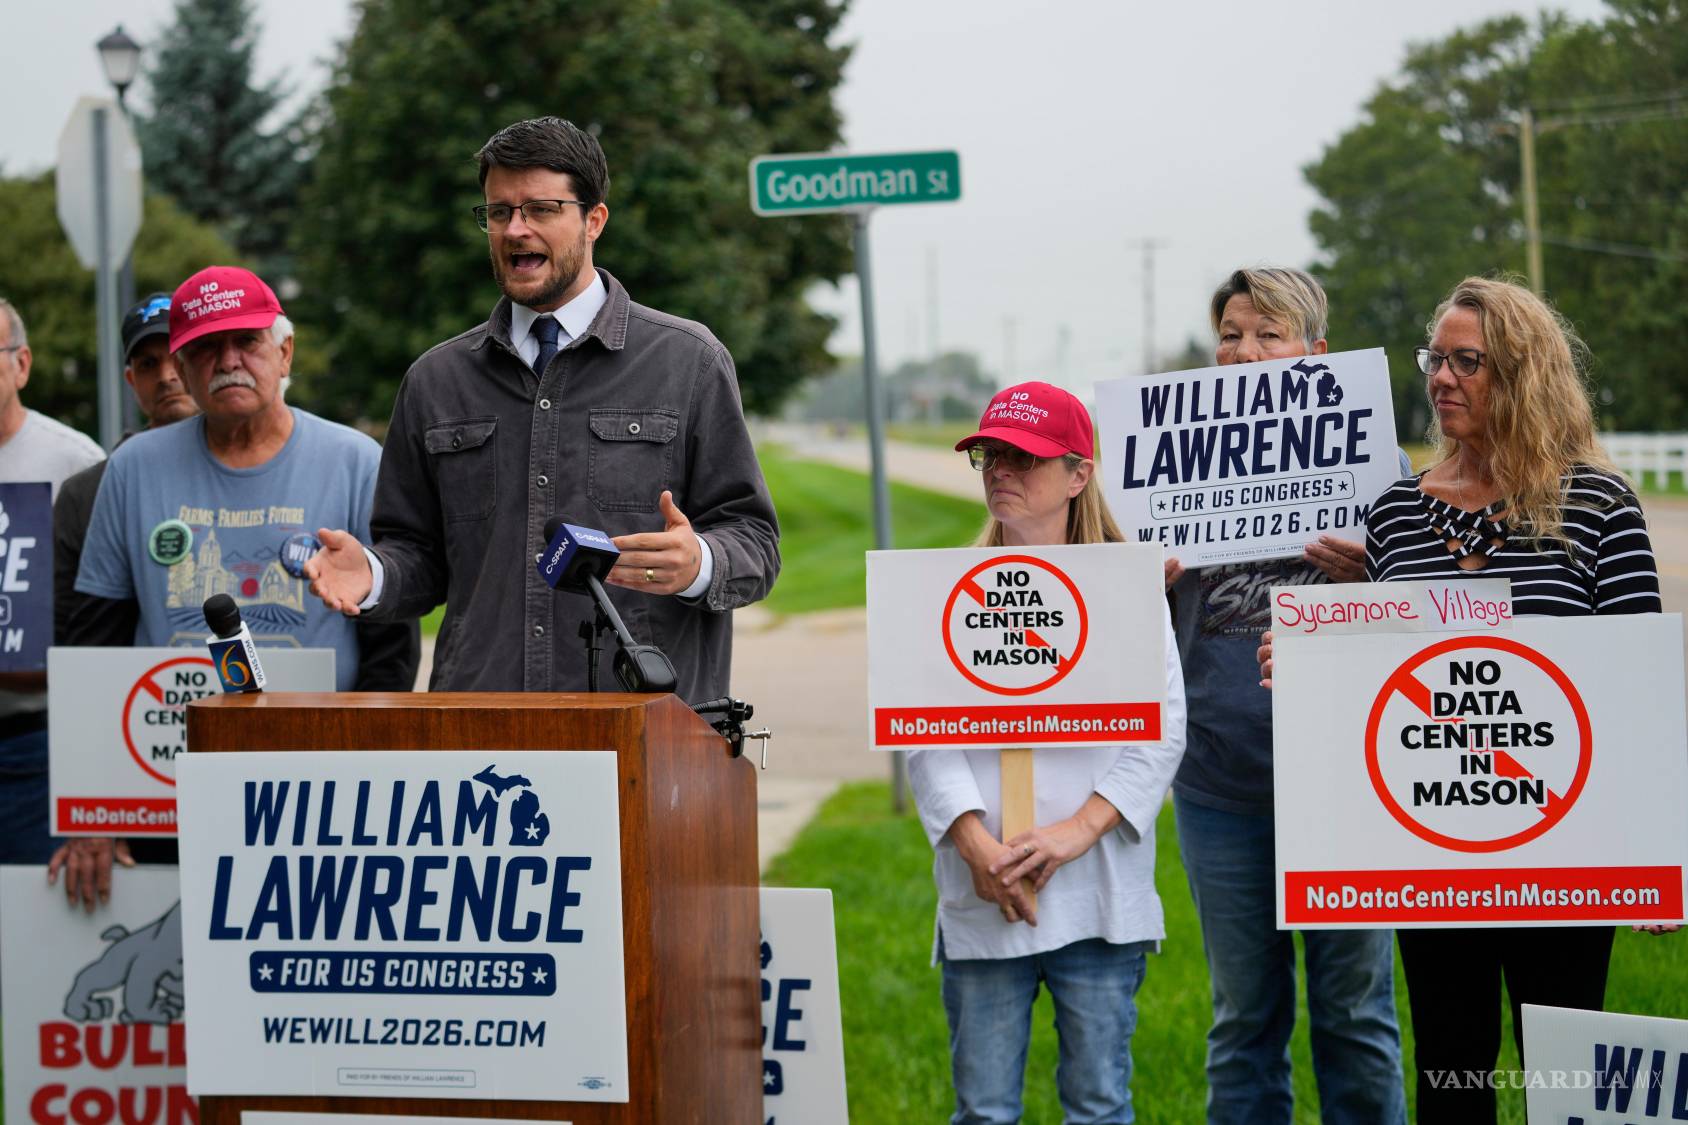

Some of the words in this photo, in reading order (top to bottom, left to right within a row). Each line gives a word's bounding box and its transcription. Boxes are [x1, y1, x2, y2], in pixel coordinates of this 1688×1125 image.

[766, 166, 917, 203] Goodman
[200, 282, 218, 294] NO
[204, 289, 245, 303] Centers
[199, 299, 241, 316] MASON
[1009, 400, 1049, 418] Centers
[1011, 392, 1029, 401] NO
[1141, 371, 1308, 428] WILLIAM
[998, 410, 1039, 424] MASON
[1123, 408, 1373, 490] LAWRENCE
[1172, 495, 1204, 513] FOR
[1212, 489, 1234, 508] US
[1240, 478, 1333, 505] CONGRESS
[179, 505, 214, 527] FARMS
[218, 509, 265, 528] FAMILIES
[268, 506, 304, 524] FUTURE
[1138, 503, 1370, 547] WEWILL2026.COM
[996, 571, 1030, 588] NO
[986, 590, 1043, 608] DATA
[1276, 592, 1420, 633] Sycamore
[1428, 588, 1512, 627] Village
[965, 611, 1064, 629] CENTERS
[1003, 631, 1024, 646] IN
[221, 644, 250, 687] 6
[973, 649, 1058, 667] MASON
[175, 671, 207, 687] NO
[1449, 660, 1501, 686] NO
[1433, 690, 1523, 717] DATA
[890, 716, 1145, 736] NoDataCentersInMason.com
[1400, 721, 1555, 750] CENTERS
[1460, 754, 1491, 775] IN
[1413, 779, 1545, 806] MASON
[244, 780, 500, 847] WILLIAM
[208, 856, 592, 943] LAWRENCE
[1306, 883, 1660, 910] NoDataCentersInMason.com
[280, 958, 331, 986] FOR
[341, 959, 375, 987] US
[383, 960, 526, 989] CONGRESS
[263, 1017, 547, 1048] WEWILL2026.COM
